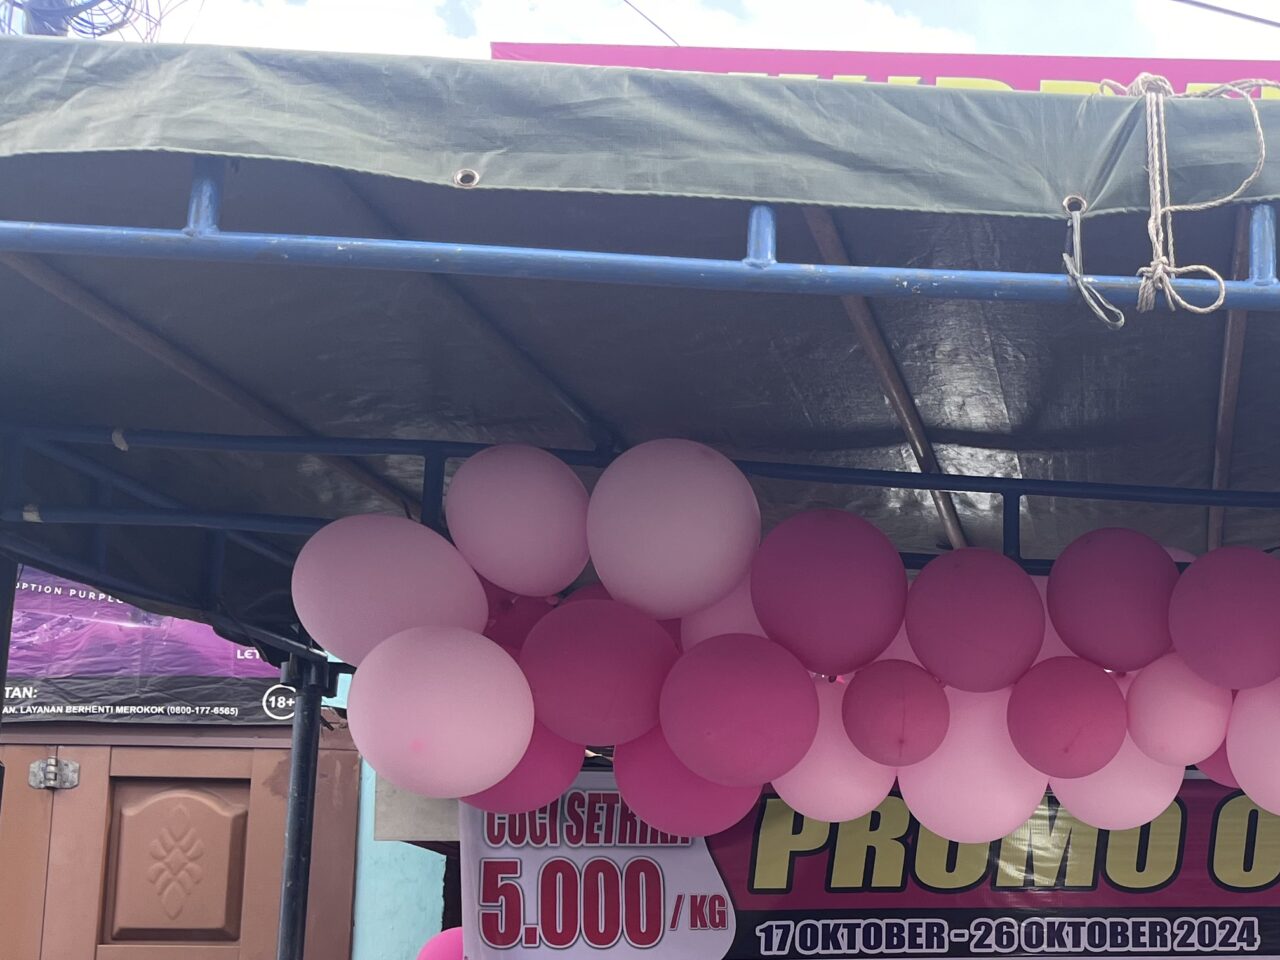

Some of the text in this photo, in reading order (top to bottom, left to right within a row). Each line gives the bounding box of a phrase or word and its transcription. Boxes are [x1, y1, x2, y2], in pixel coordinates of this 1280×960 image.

[20, 705, 63, 715] LAYANAN
[65, 705, 114, 715] BERHENTI
[115, 705, 165, 715] MEROKOK
[267, 695, 296, 709] 18+
[563, 790, 693, 847] SETR
[479, 856, 665, 950] 5.000
